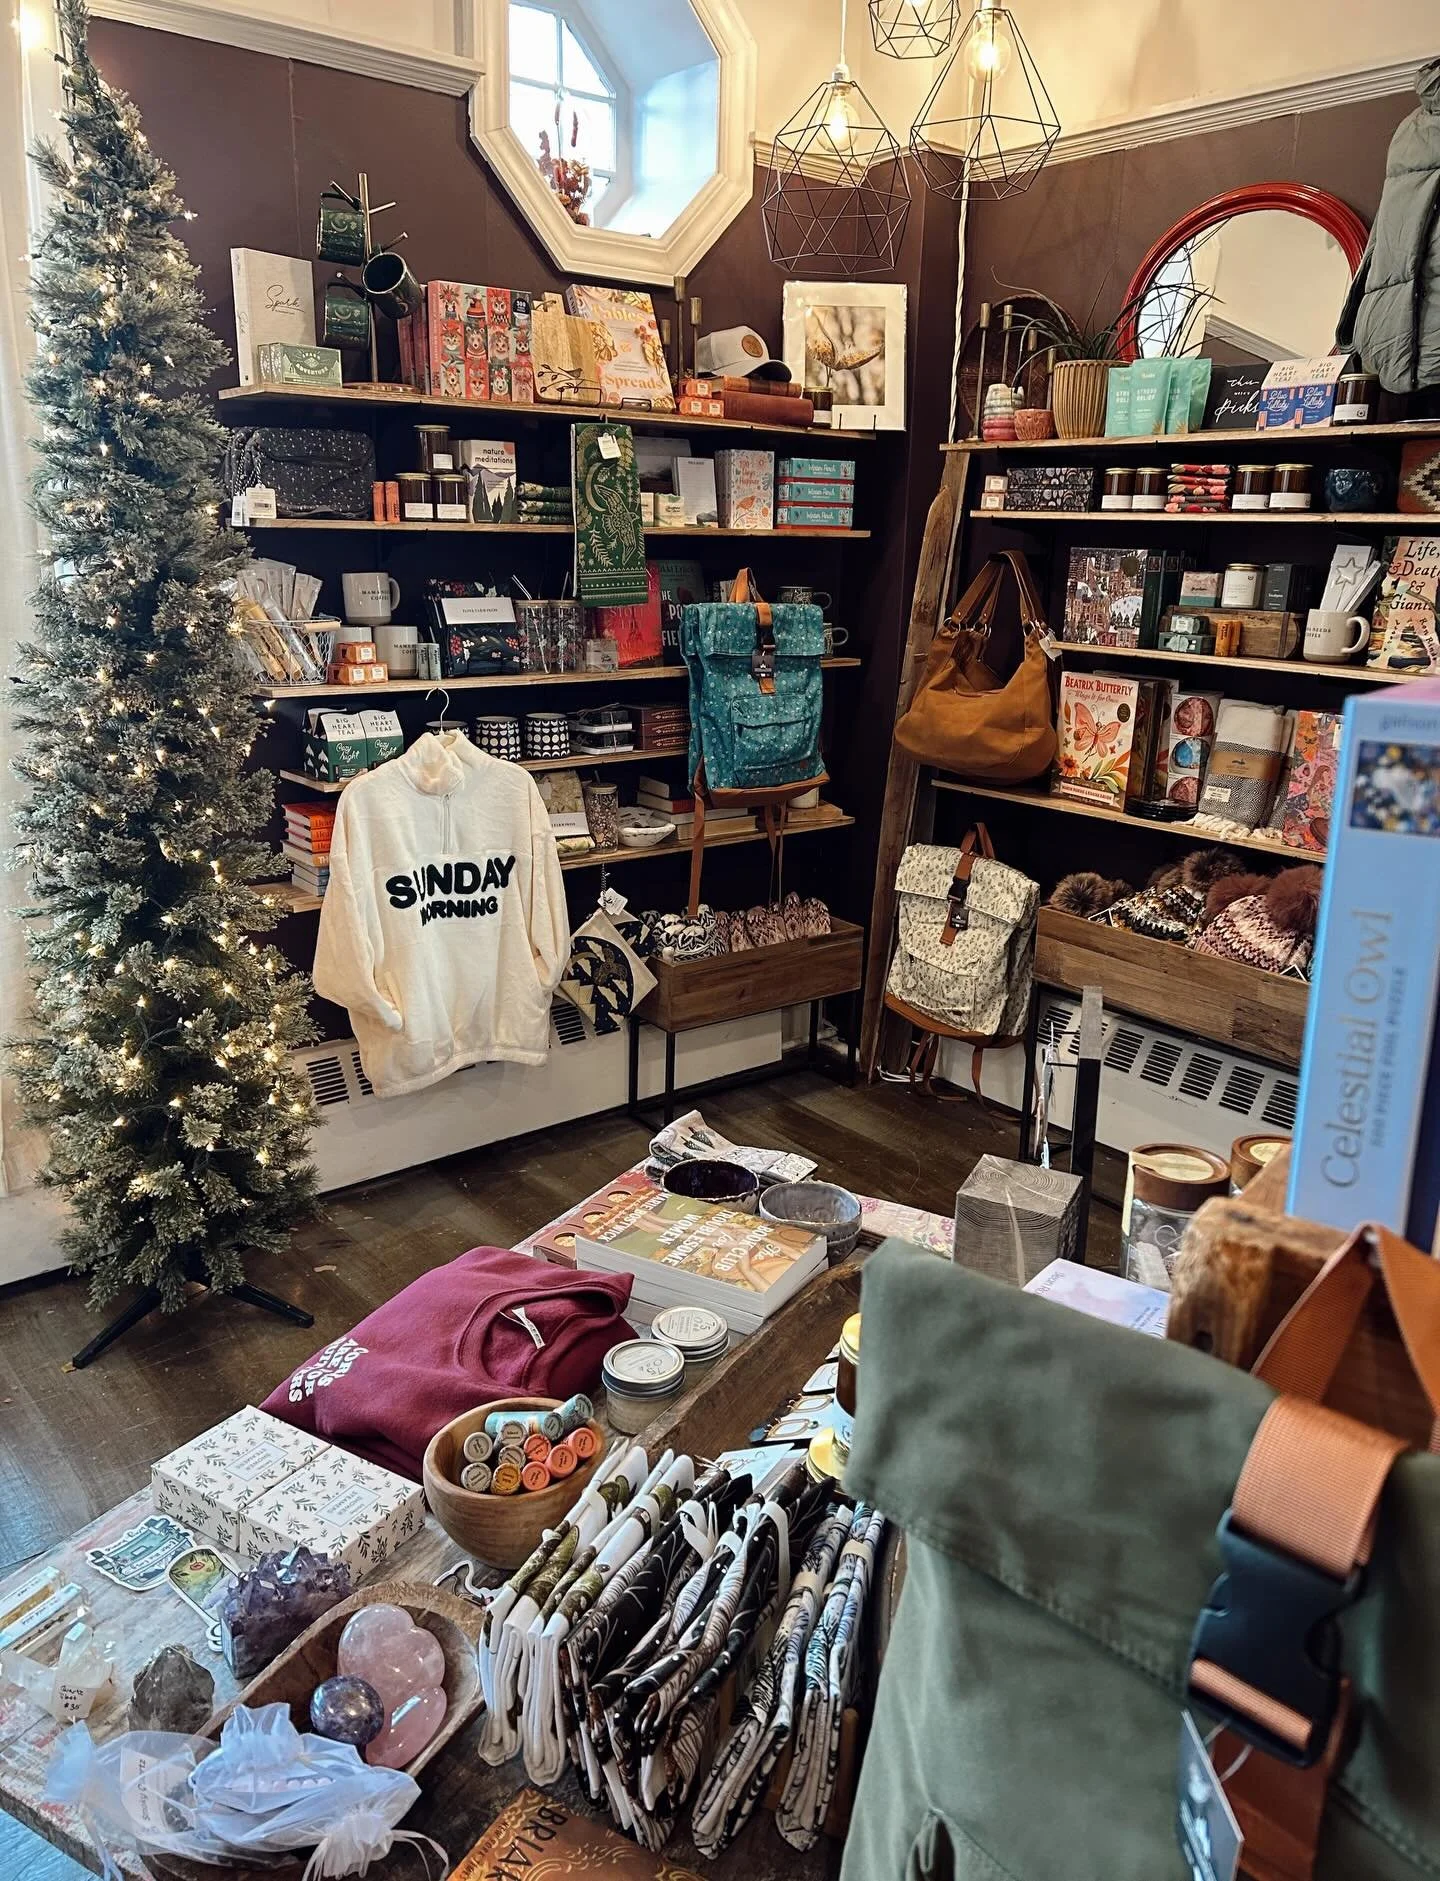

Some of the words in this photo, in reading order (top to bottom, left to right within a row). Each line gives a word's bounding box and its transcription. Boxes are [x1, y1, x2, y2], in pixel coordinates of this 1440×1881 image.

[592, 303, 645, 322] Tables
[604, 375, 665, 391] Spreads
[474, 456, 514, 465] meditations
[482, 448, 505, 456] nature
[1404, 540, 1440, 562] Life,
[662, 590, 672, 601] HE
[1408, 581, 1426, 595] &
[1420, 616, 1429, 636] Ron
[662, 630, 681, 647] FIE
[1065, 676, 1094, 691] BEATRIX
[1095, 680, 1134, 697] BUTTERFLY
[336, 742, 352, 755] Cozy
[374, 739, 390, 752] Cozy
[386, 855, 516, 909] SUNDAY
[420, 896, 498, 926] MORNING
[1343, 908, 1393, 1005] Owl
[1319, 1013, 1378, 1189] Celestial
[640, 1192, 674, 1216] MARIE
[597, 1208, 648, 1243] BOSTWICK
[656, 1213, 703, 1245] WOMEN
[661, 1209, 738, 1267] TROUBLESOME
[742, 1224, 775, 1251] BOOK
[714, 1246, 750, 1272] CLUB
[752, 1243, 782, 1262] The
